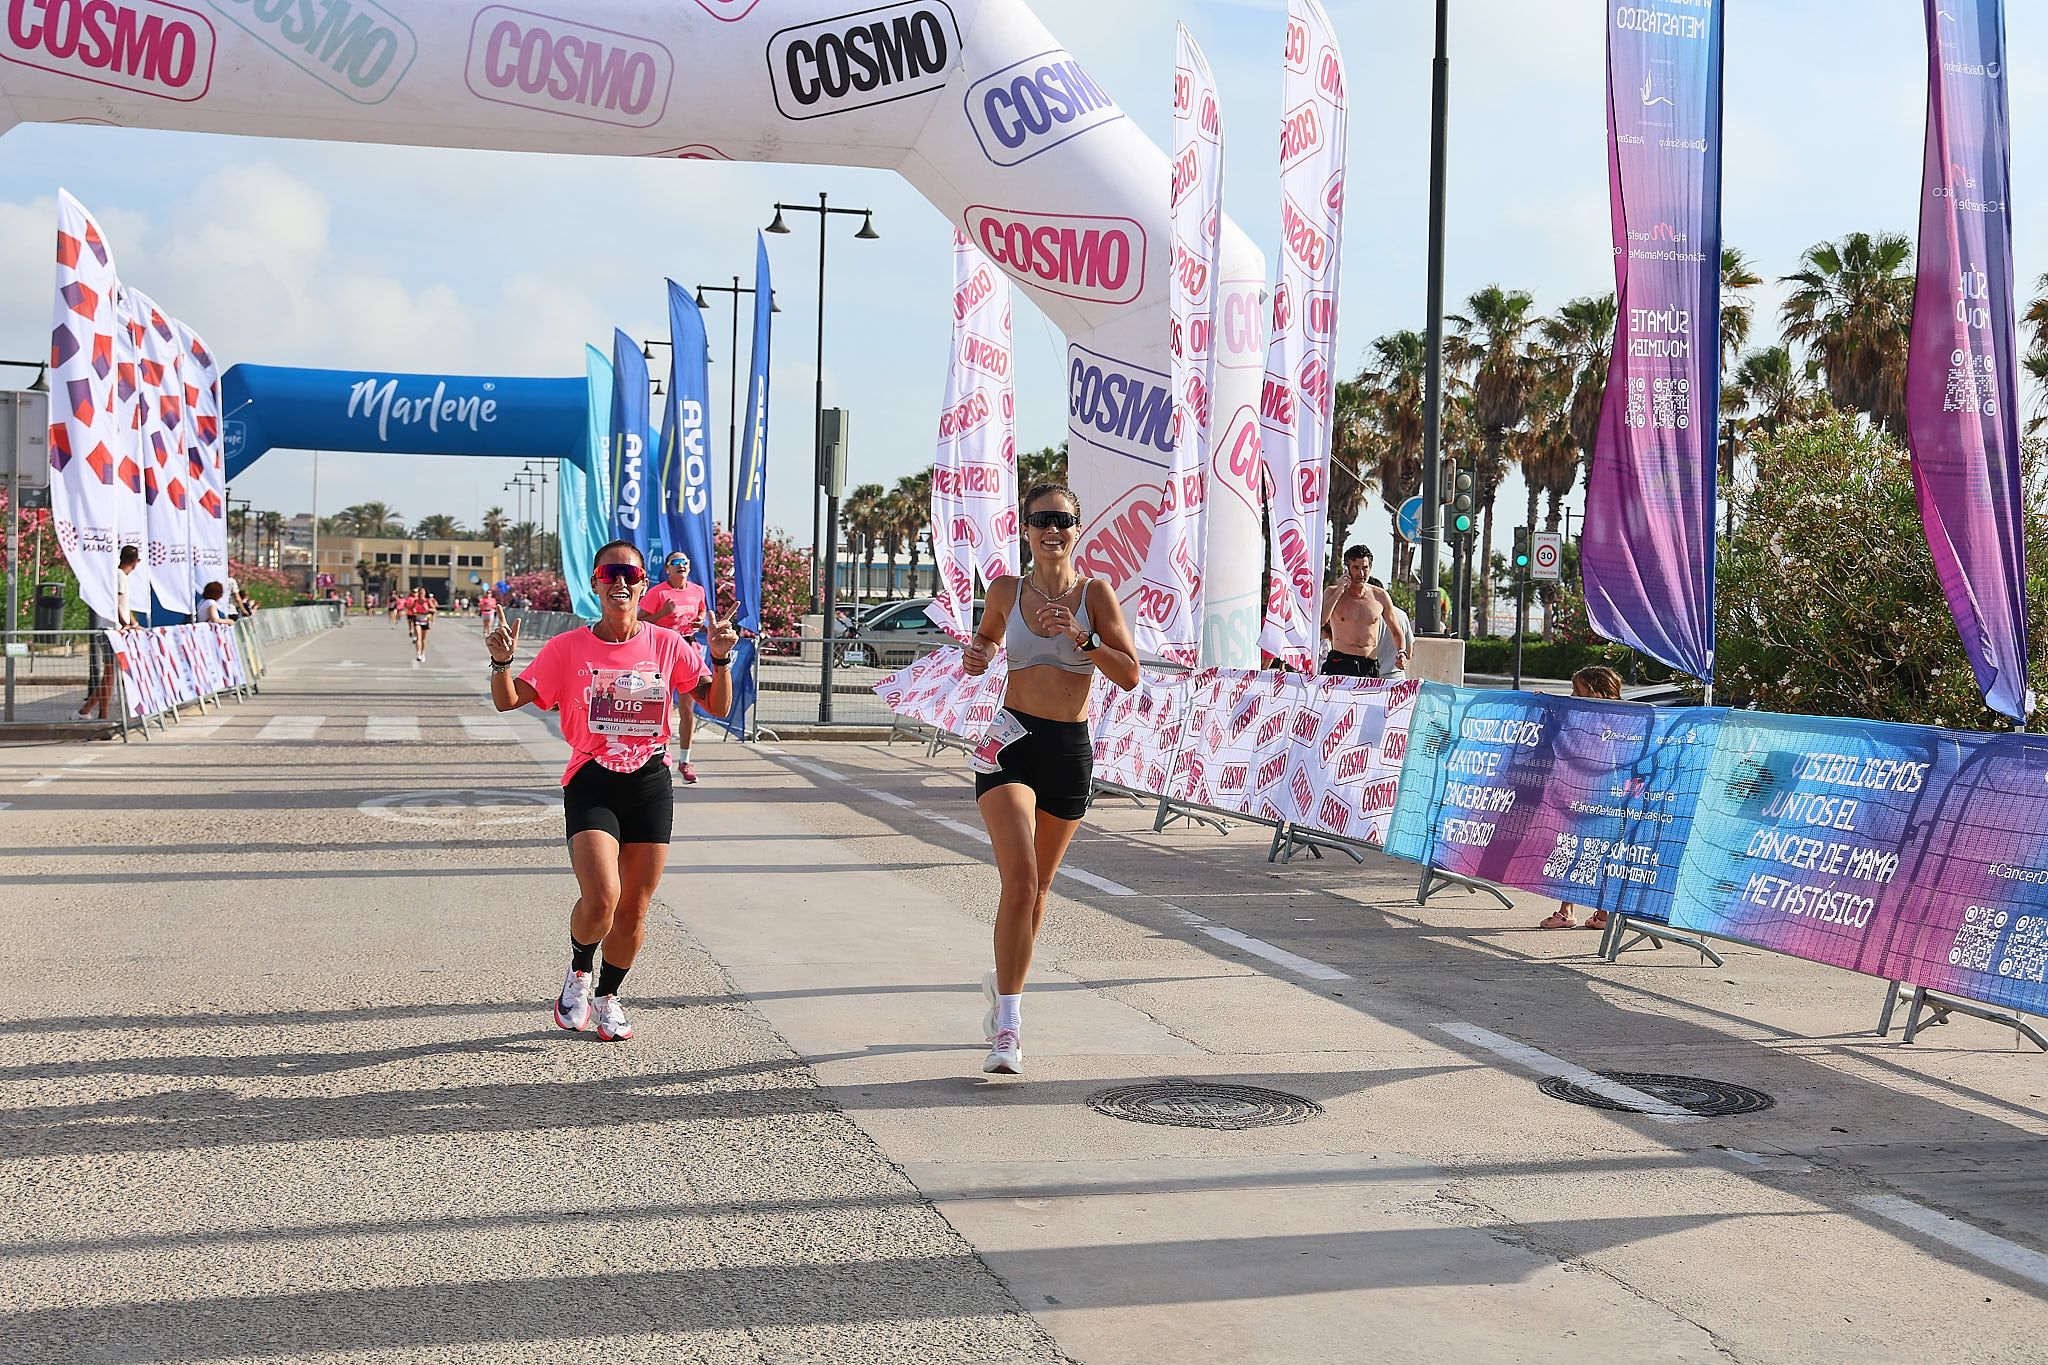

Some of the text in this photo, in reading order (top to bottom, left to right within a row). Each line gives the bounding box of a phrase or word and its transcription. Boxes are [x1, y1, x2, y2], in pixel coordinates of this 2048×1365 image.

[8, 0, 196, 88] COSMO
[786, 10, 946, 105] COSMO
[484, 20, 656, 116] COSMO
[980, 217, 1130, 290] COSMO
[347, 378, 497, 442] Marlene
[1540, 551, 1553, 560] 30
[614, 700, 643, 711] 016
[966, 706, 993, 723] COSMO
[1231, 697, 1261, 740] COSMO
[1256, 710, 1286, 747] COSMO
[1291, 710, 1320, 742] COSMO
[1322, 708, 1355, 762] COSMO
[1219, 766, 1247, 790] COSMO
[1257, 753, 1287, 790] COSMO
[1337, 746, 1370, 780] COSMO
[1791, 751, 1930, 793] VISIBILICEMOS
[1291, 766, 1314, 818] COSMO
[1363, 780, 1398, 814] COSMO
[1761, 790, 1858, 831] JUNTOS EL
[1320, 795, 1350, 835] COSMO
[1607, 838, 1652, 866] SÚMATE
[1746, 824, 1899, 884] CÁNCER DE MAMA
[1602, 863, 1657, 885] MOVIMIENTO
[1741, 871, 1875, 929] METASTÁSICO
